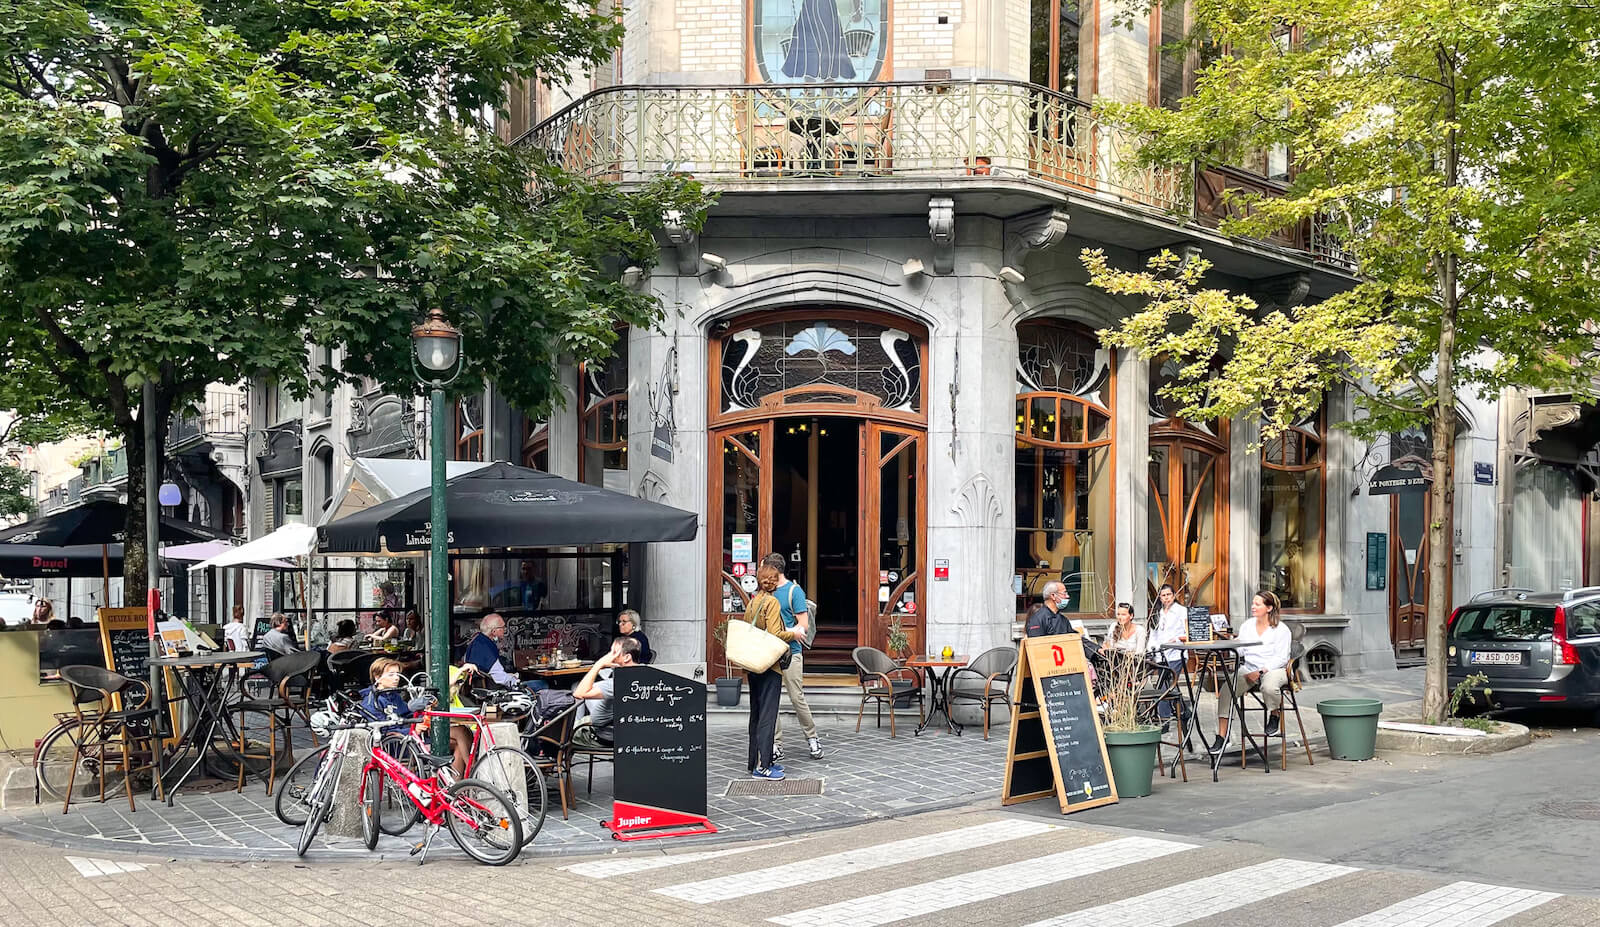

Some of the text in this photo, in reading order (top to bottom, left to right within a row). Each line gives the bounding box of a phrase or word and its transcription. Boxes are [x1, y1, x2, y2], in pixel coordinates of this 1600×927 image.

[32, 555, 69, 569] Duvel
[631, 680, 673, 699] Suggestion
[667, 694, 683, 706] Jour
[617, 816, 651, 827] Jupiler
